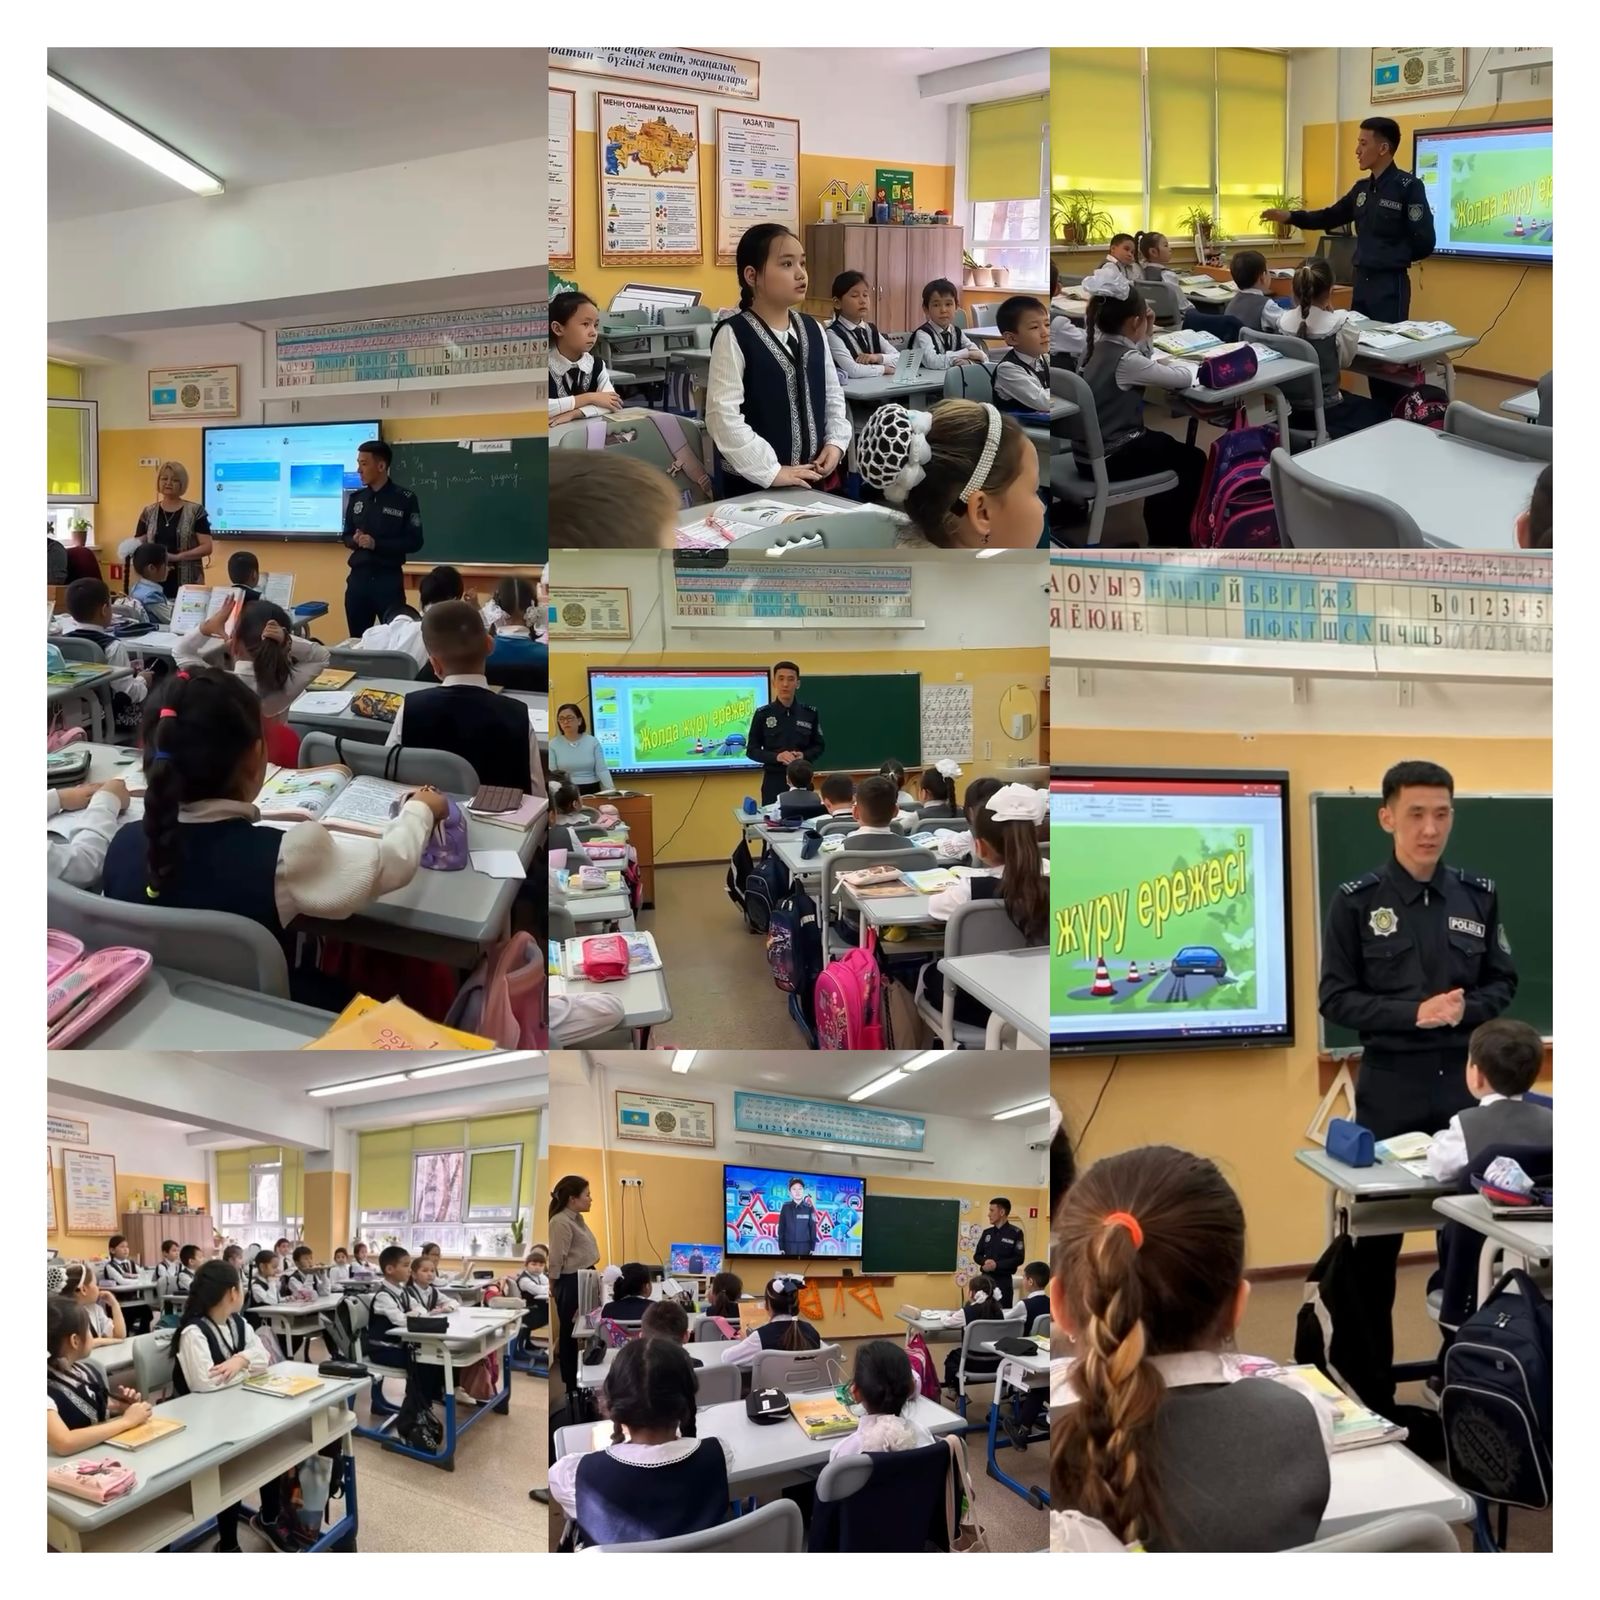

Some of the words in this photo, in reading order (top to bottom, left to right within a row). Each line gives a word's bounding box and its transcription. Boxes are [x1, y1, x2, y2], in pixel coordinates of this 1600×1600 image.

[607, 53, 645, 69] бүгінгі
[646, 62, 689, 76] мектеп
[690, 69, 748, 87] оқушылары
[658, 51, 686, 65] етіп,
[688, 57, 737, 75] жаңалық
[603, 98, 625, 108] МЕНІҢ
[625, 102, 656, 111] ОТАНЫМ
[742, 117, 763, 128] ҚАЗАҚ
[1455, 194, 1497, 232] Жолда
[464, 347, 468, 357] 1
[474, 346, 478, 357] 2
[483, 346, 488, 356] 3
[493, 345, 498, 355] 4
[503, 344, 508, 354] 5
[512, 343, 517, 354] 6
[522, 342, 528, 352] 7
[532, 341, 537, 352] 8
[542, 340, 547, 350] 9
[1050, 573, 1059, 593] А
[1068, 573, 1081, 594] О
[1089, 574, 1100, 595] У
[1107, 576, 1122, 597] Ы
[1129, 576, 1141, 597] Э
[1150, 578, 1161, 598] Н
[1168, 580, 1182, 600] М
[1211, 582, 1220, 601] Р
[1229, 578, 1241, 603] Й
[1250, 584, 1259, 604] Б
[1268, 585, 1278, 605] В
[1287, 586, 1296, 606] Г
[1305, 587, 1316, 608] Д
[1321, 588, 1337, 608] Ж
[1344, 589, 1352, 609] З
[1431, 594, 1443, 613] Ъ
[1468, 597, 1475, 615] 1
[1486, 597, 1493, 615] 2
[1502, 598, 1510, 616] 3
[1536, 600, 1543, 618] 5
[1050, 607, 1062, 628] Я
[1071, 603, 1082, 629] Ё
[1088, 608, 1105, 629] Ю
[1111, 611, 1123, 631] И
[1132, 611, 1143, 632] Е
[1250, 618, 1261, 637] П
[1268, 619, 1281, 638] Ф
[1289, 620, 1299, 639] К
[1308, 621, 1316, 639] Т
[1323, 621, 1338, 640] Ш
[1344, 622, 1355, 642] С
[1361, 623, 1373, 642] Х
[1379, 623, 1391, 644] Ц
[1398, 624, 1407, 643] Ч
[1413, 625, 1428, 646] Щ
[1433, 626, 1443, 645] Ь
[640, 723, 680, 753] Жолда
[1055, 888, 1130, 963] жүру
[1136, 832, 1247, 940] ережесі
[380, 1028, 413, 1050] ОБУ
